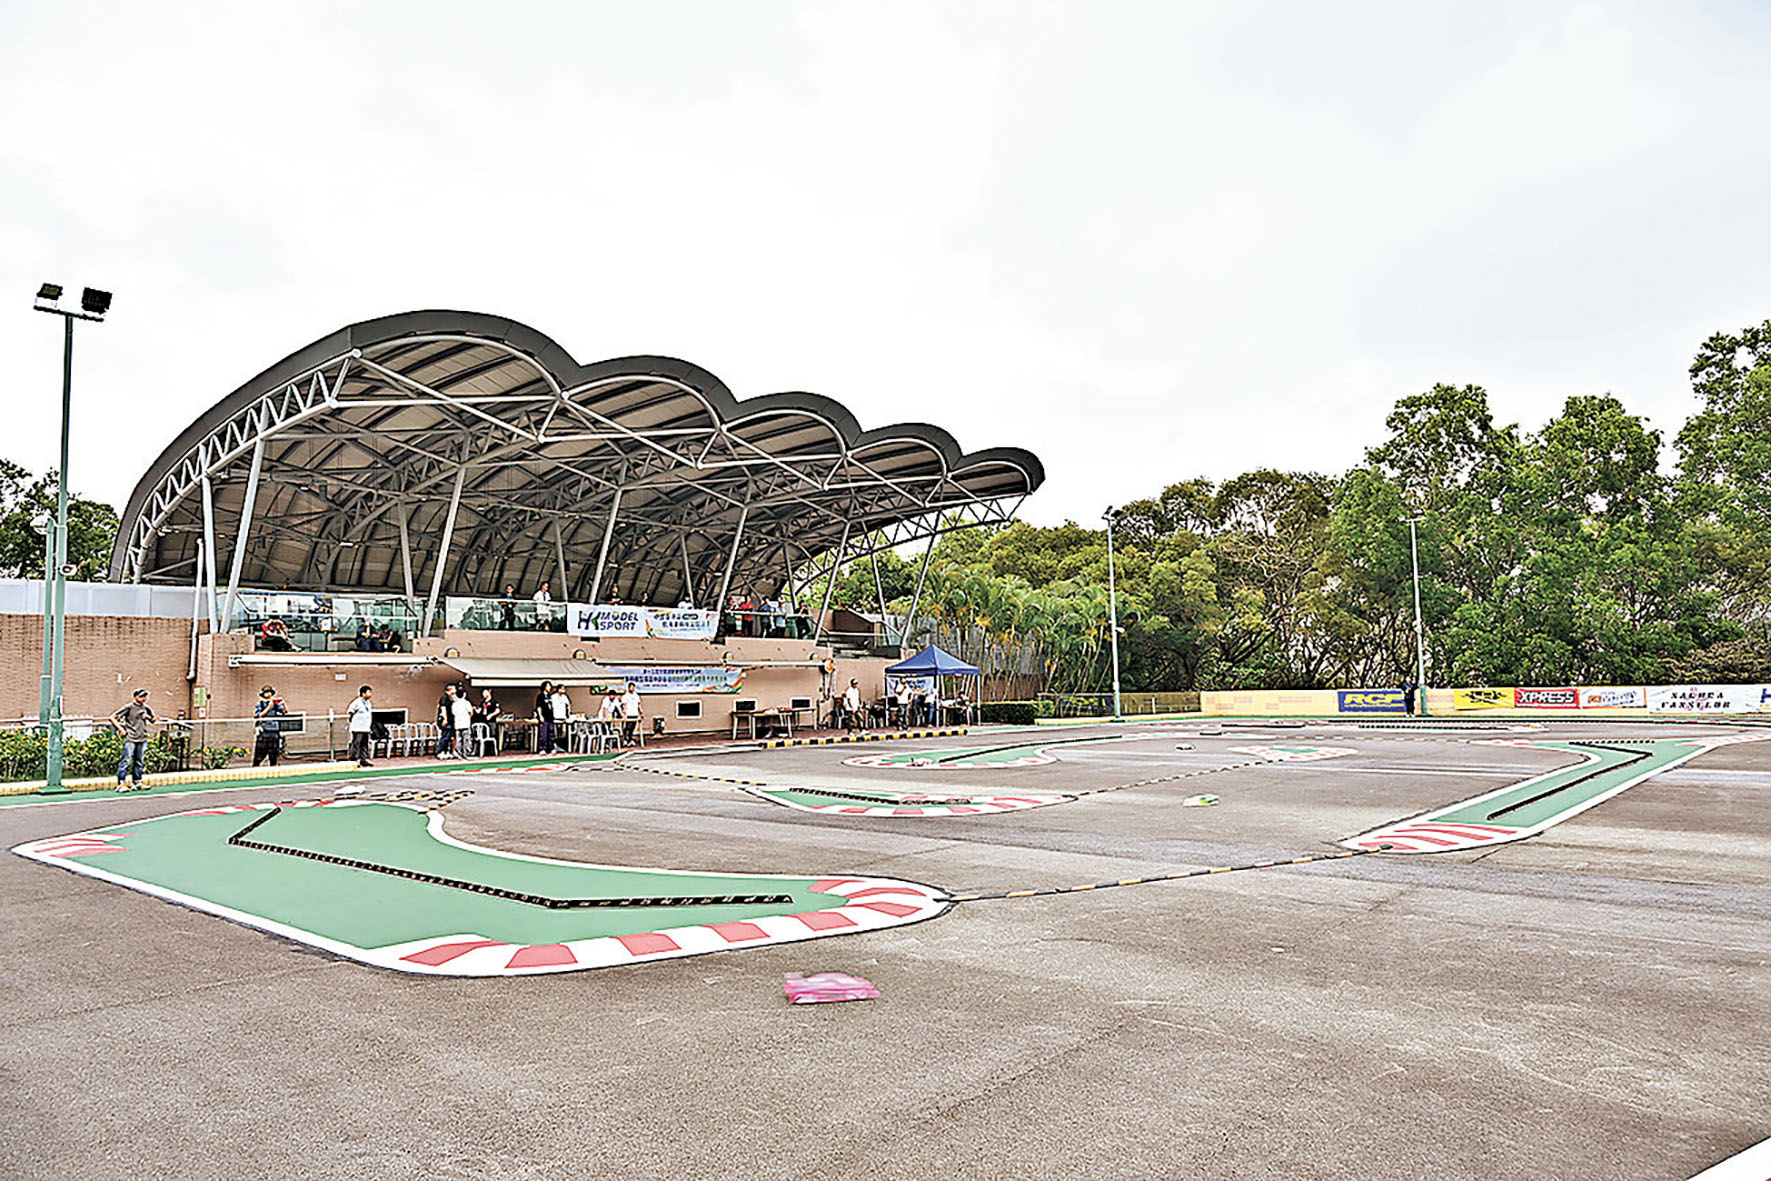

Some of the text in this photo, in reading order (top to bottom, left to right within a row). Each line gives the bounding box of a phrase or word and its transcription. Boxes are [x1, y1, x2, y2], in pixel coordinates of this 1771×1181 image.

[601, 611, 639, 621] MODEL
[600, 621, 636, 631] SPORT
[1520, 691, 1575, 704] XPRESS
